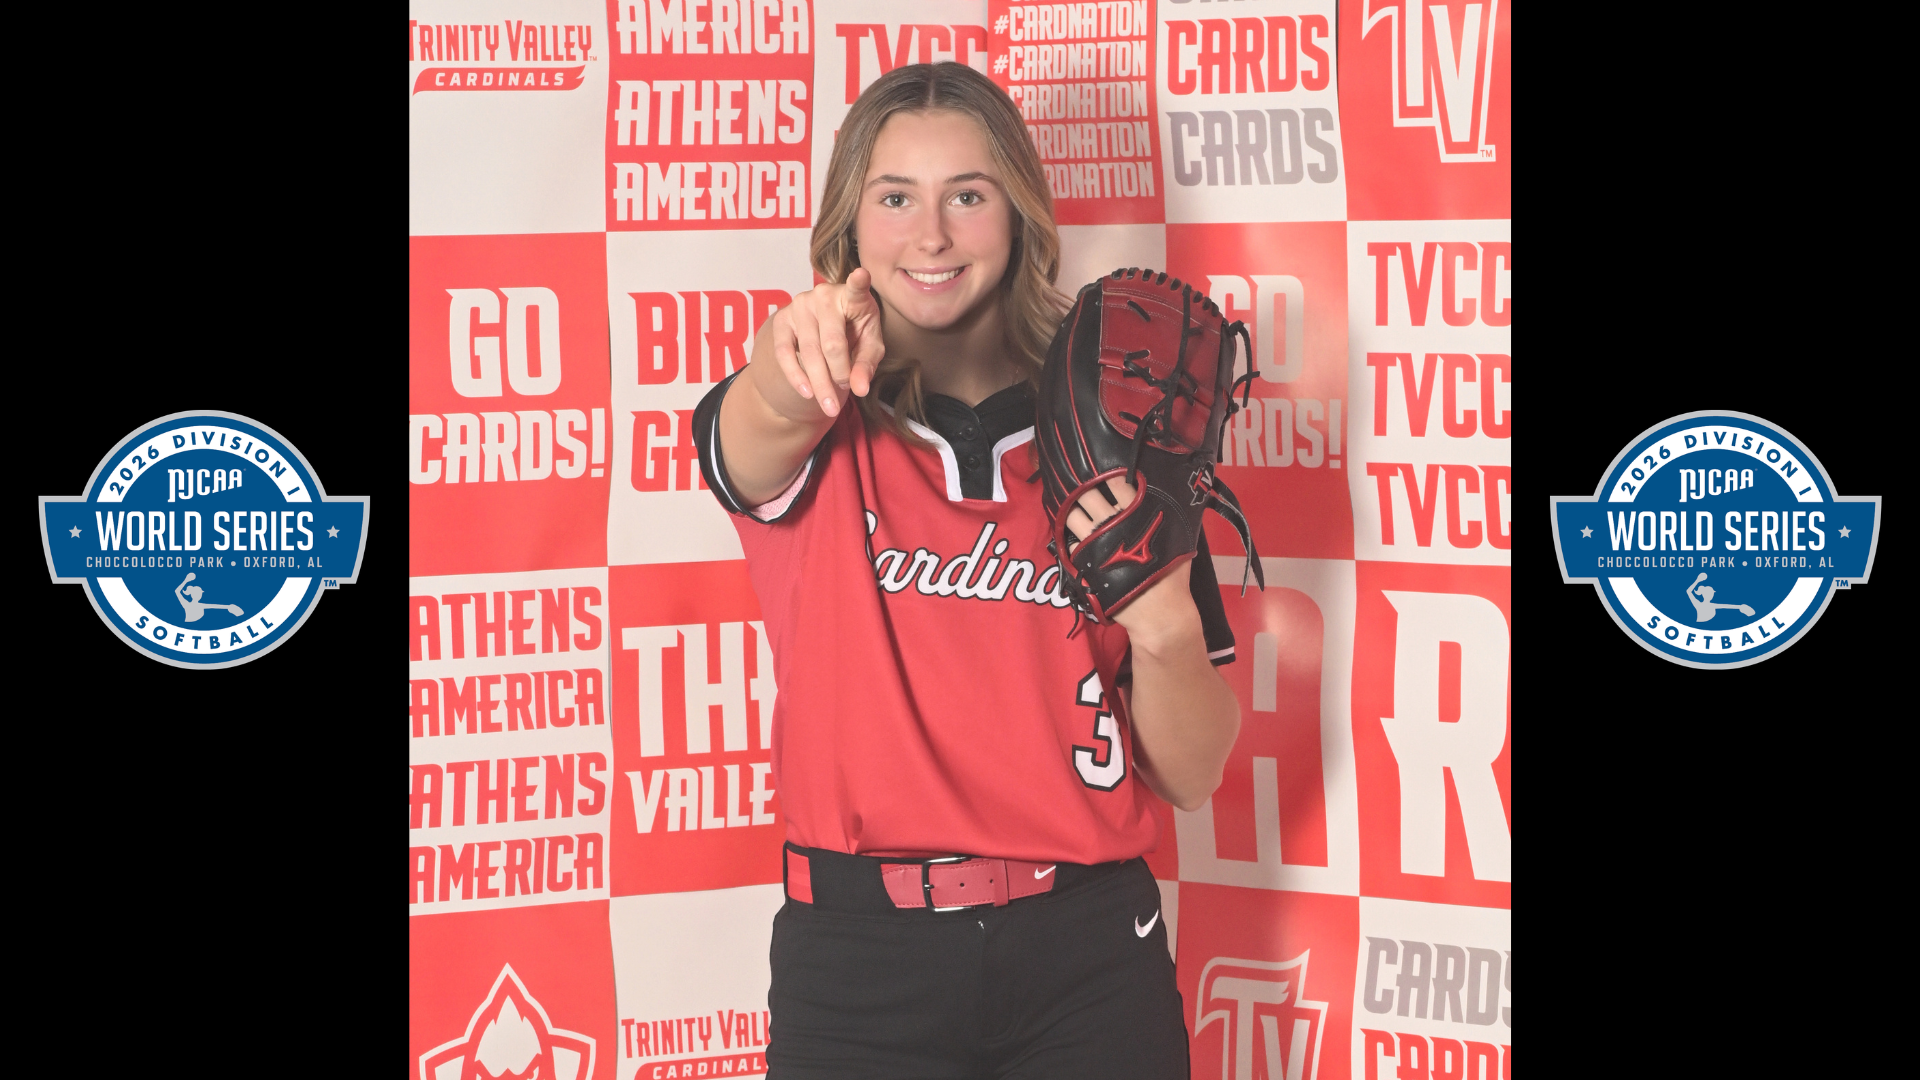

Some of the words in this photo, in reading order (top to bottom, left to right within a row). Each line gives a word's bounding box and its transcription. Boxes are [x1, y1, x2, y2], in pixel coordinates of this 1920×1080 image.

[505, 20, 592, 62] VALLEY
[616, 0, 809, 54] AMERICA
[994, 0, 1148, 42] #CARDNATION
[1164, 14, 1330, 96] CARDS
[435, 72, 564, 87] CARDINALS
[993, 41, 1147, 81] #CARDNATION
[614, 79, 807, 146] ATHENS
[1165, 108, 1339, 187] CARDS
[612, 160, 806, 221] AMERICA
[1367, 241, 1511, 327] TVCC
[445, 287, 562, 398] GO
[1366, 352, 1511, 439] TVCC
[409, 407, 606, 485] CARDS!
[1366, 462, 1511, 550] TVCC
[409, 586, 603, 662] ATHENS
[409, 667, 605, 738] AMERICA
[409, 751, 607, 829] ATHENS
[624, 762, 776, 834] VALLE
[409, 832, 604, 904] AMERICA
[621, 1015, 712, 1058] TRINITY
[716, 1009, 772, 1049] VALL
[652, 1056, 769, 1080] CARDINAL
